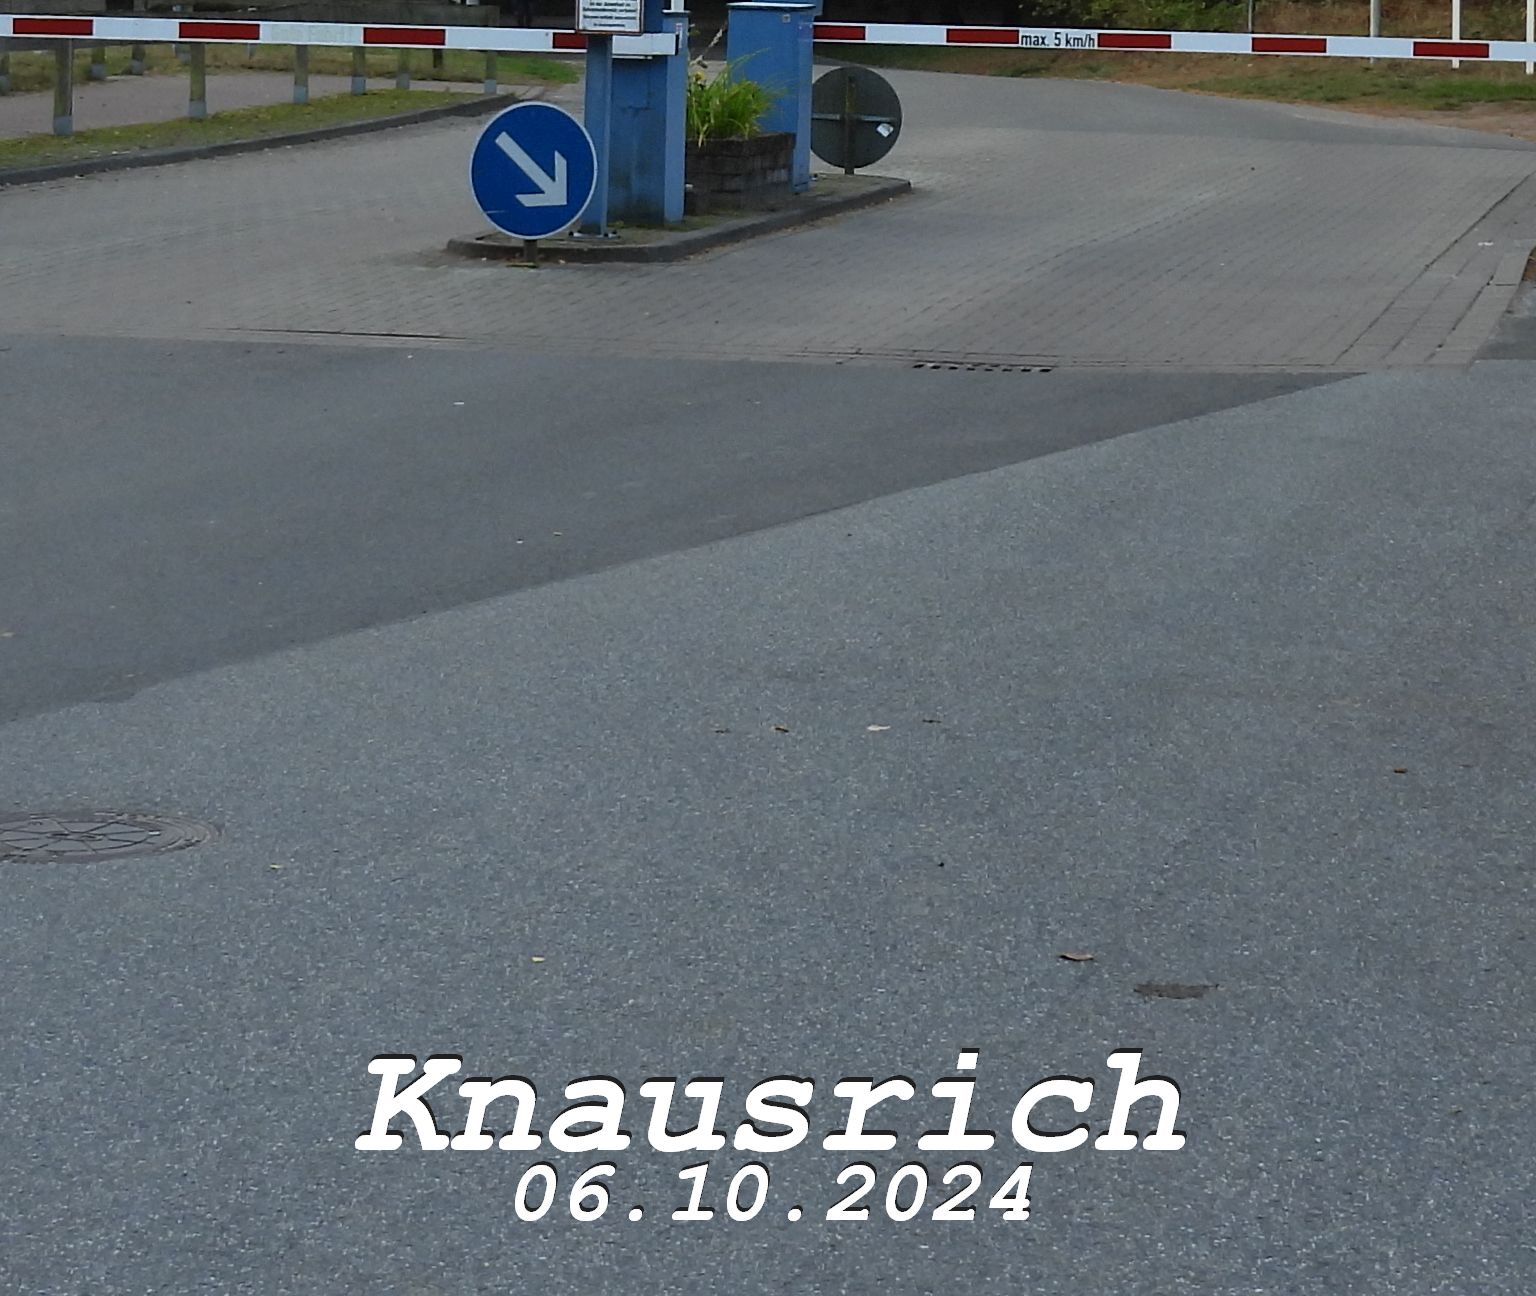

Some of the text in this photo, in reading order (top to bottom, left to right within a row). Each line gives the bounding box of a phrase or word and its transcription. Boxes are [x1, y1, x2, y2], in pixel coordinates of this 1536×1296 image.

[1021, 32, 1096, 48] max. 5 km/h
